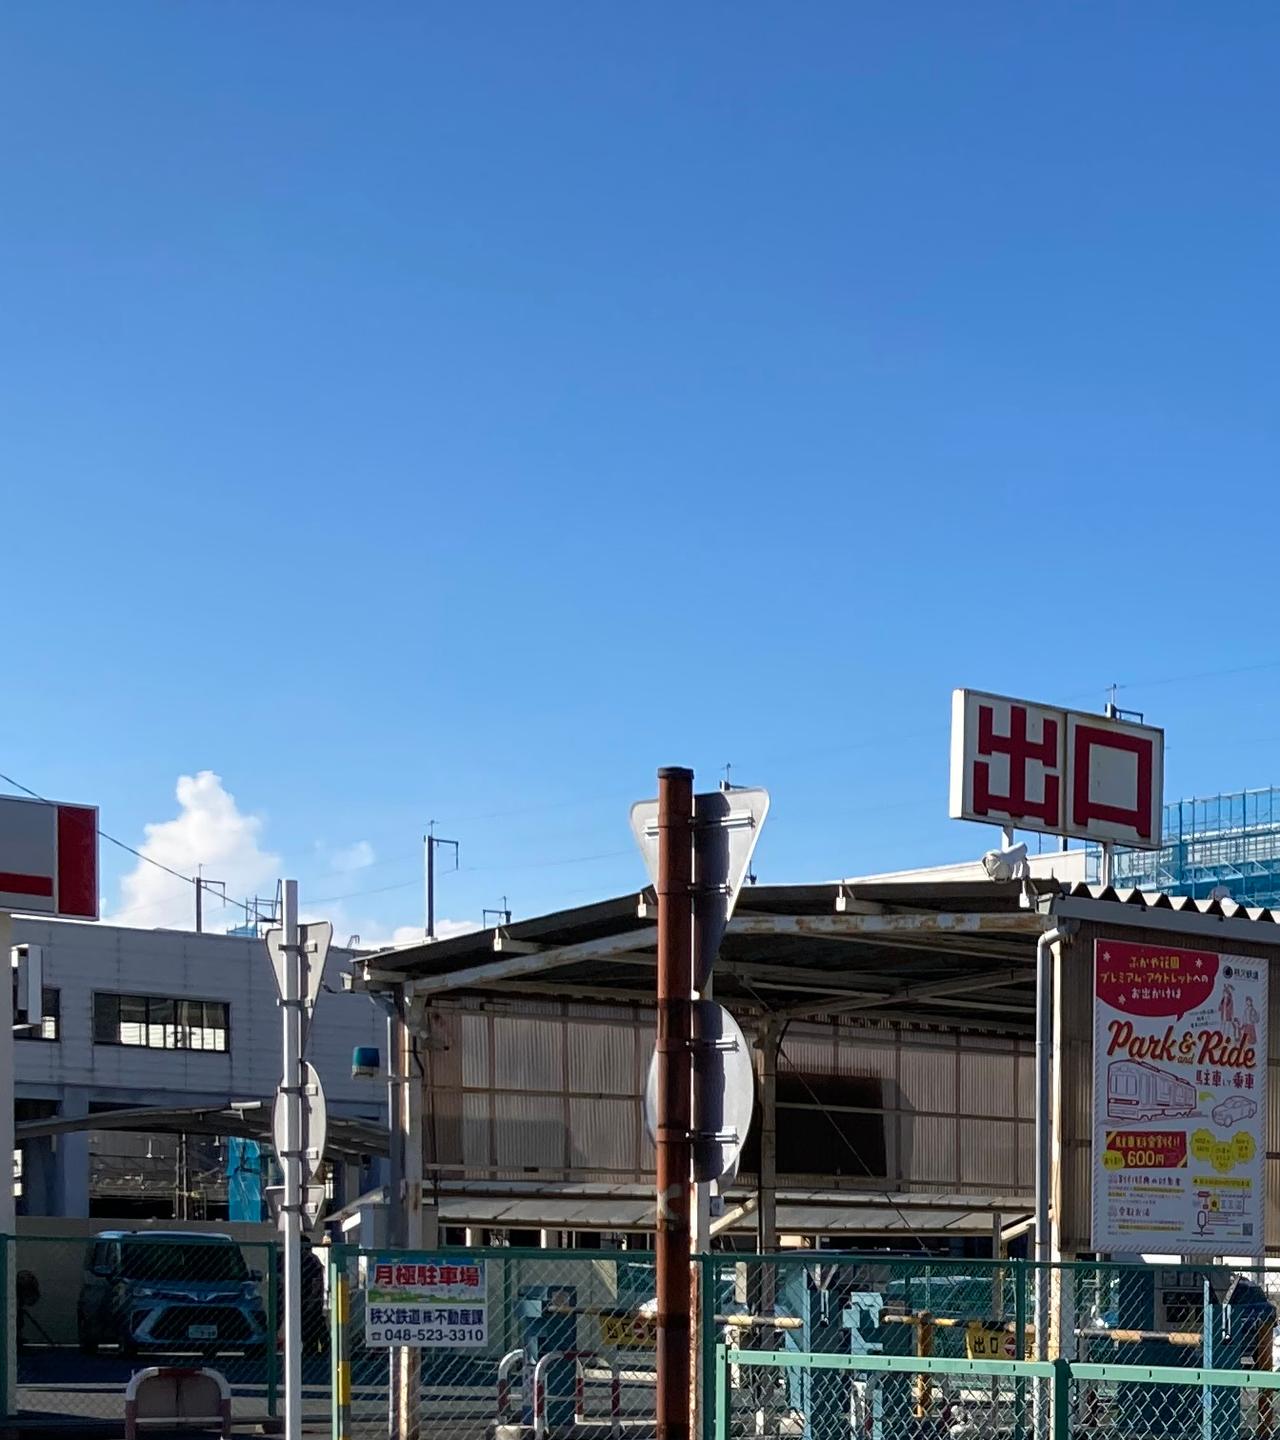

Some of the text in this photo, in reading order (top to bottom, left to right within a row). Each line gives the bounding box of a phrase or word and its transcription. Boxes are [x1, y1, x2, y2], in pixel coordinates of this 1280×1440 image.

[973, 704, 1153, 838] 出口
[1131, 987, 1182, 1000] お出かけは
[1106, 1019, 1177, 1062] Park
[1178, 1031, 1196, 1055] &
[1197, 1030, 1256, 1069] Ride
[374, 1264, 480, 1287] 月極駐車場
[384, 1329, 484, 1342] 048-523-3310
[974, 1336, 999, 1354] 出口
